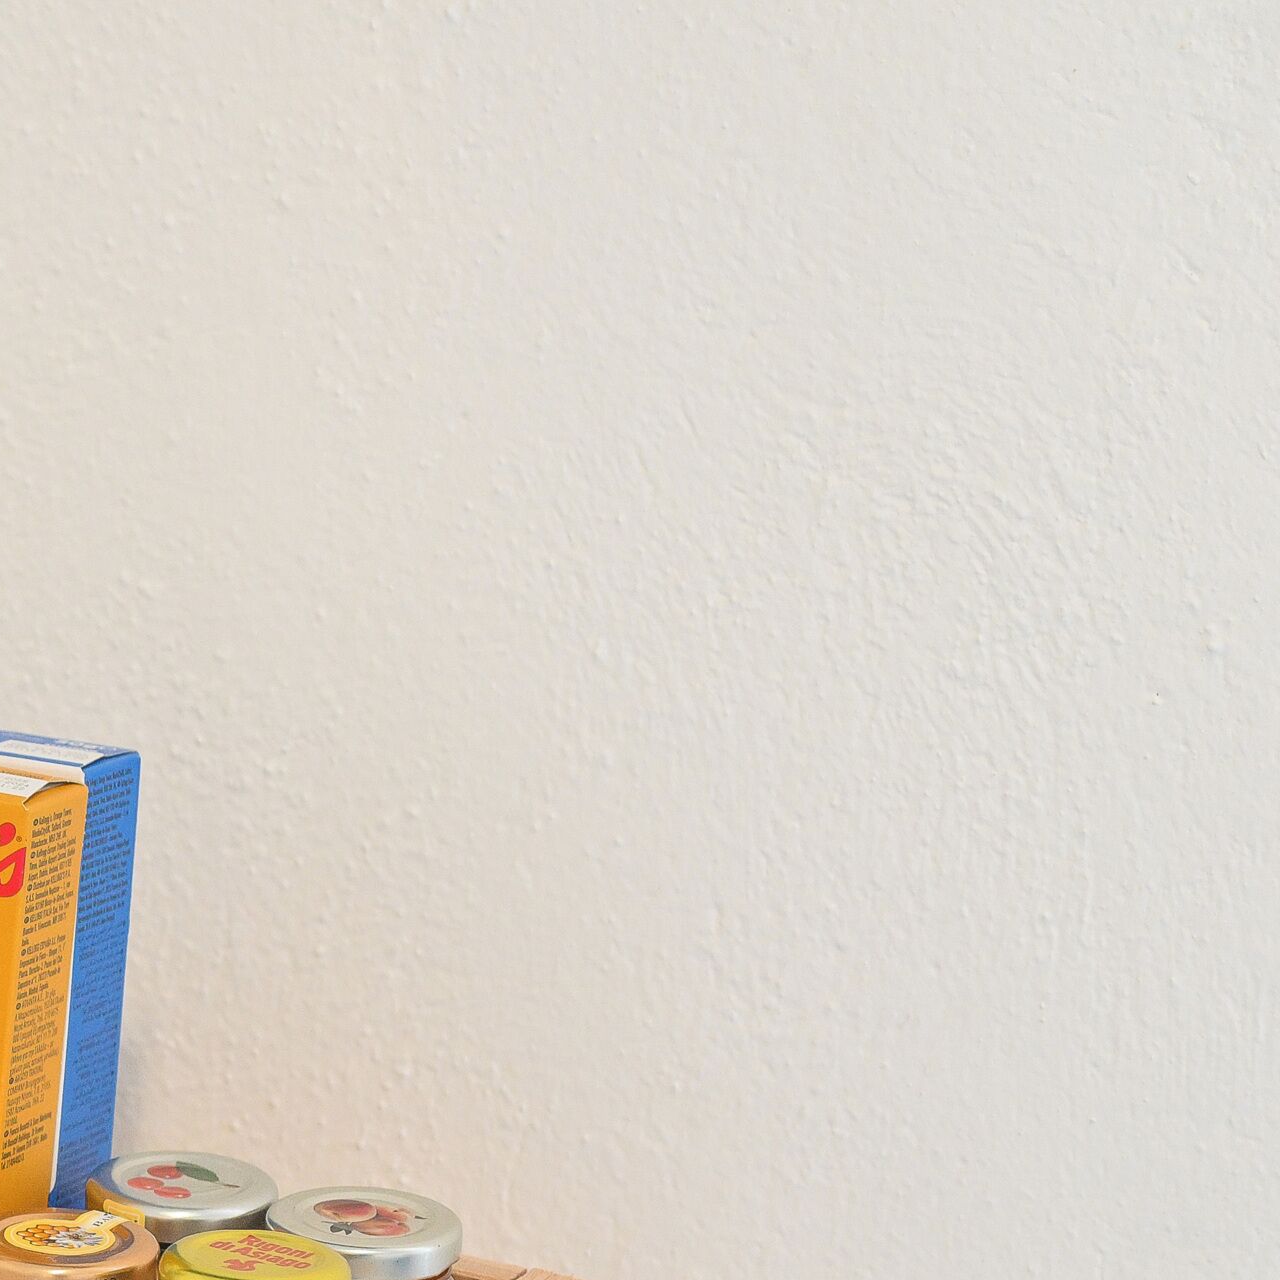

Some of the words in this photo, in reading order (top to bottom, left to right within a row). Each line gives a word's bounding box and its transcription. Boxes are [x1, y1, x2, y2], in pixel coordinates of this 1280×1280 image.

[209, 1241, 236, 1251] di
[230, 1247, 312, 1269] Asiago
[237, 1235, 315, 1259] Rigoni
